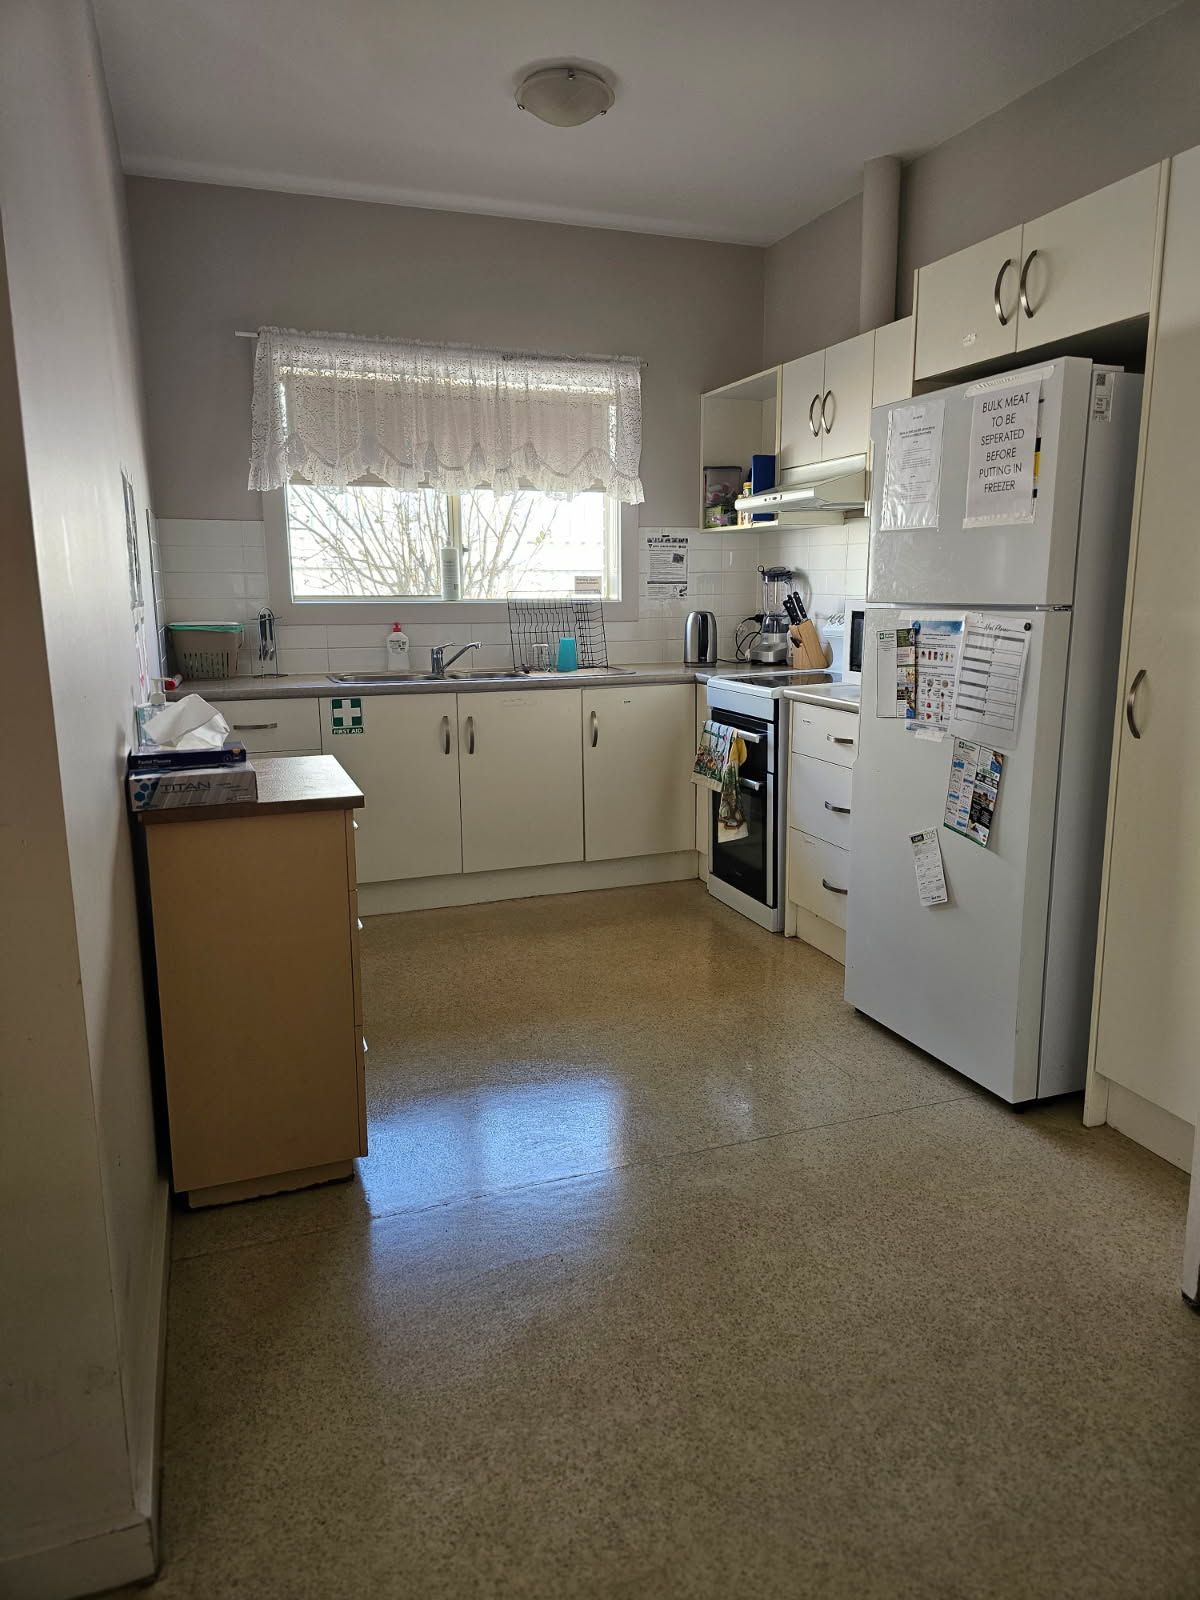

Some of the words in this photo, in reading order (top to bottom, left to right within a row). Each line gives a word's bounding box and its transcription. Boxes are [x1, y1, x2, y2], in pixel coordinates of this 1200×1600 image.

[982, 401, 1003, 413] BULK
[1005, 392, 1031, 409] MEAT
[992, 416, 1003, 427] TO
[1005, 413, 1017, 425] BE
[981, 428, 1025, 446] SEPERATED
[986, 447, 1017, 462] BEFORE
[979, 464, 1012, 478] PUTTING
[1013, 463, 1022, 473] IN
[984, 480, 1016, 493] FREEZER
[160, 781, 211, 794] TITAN
